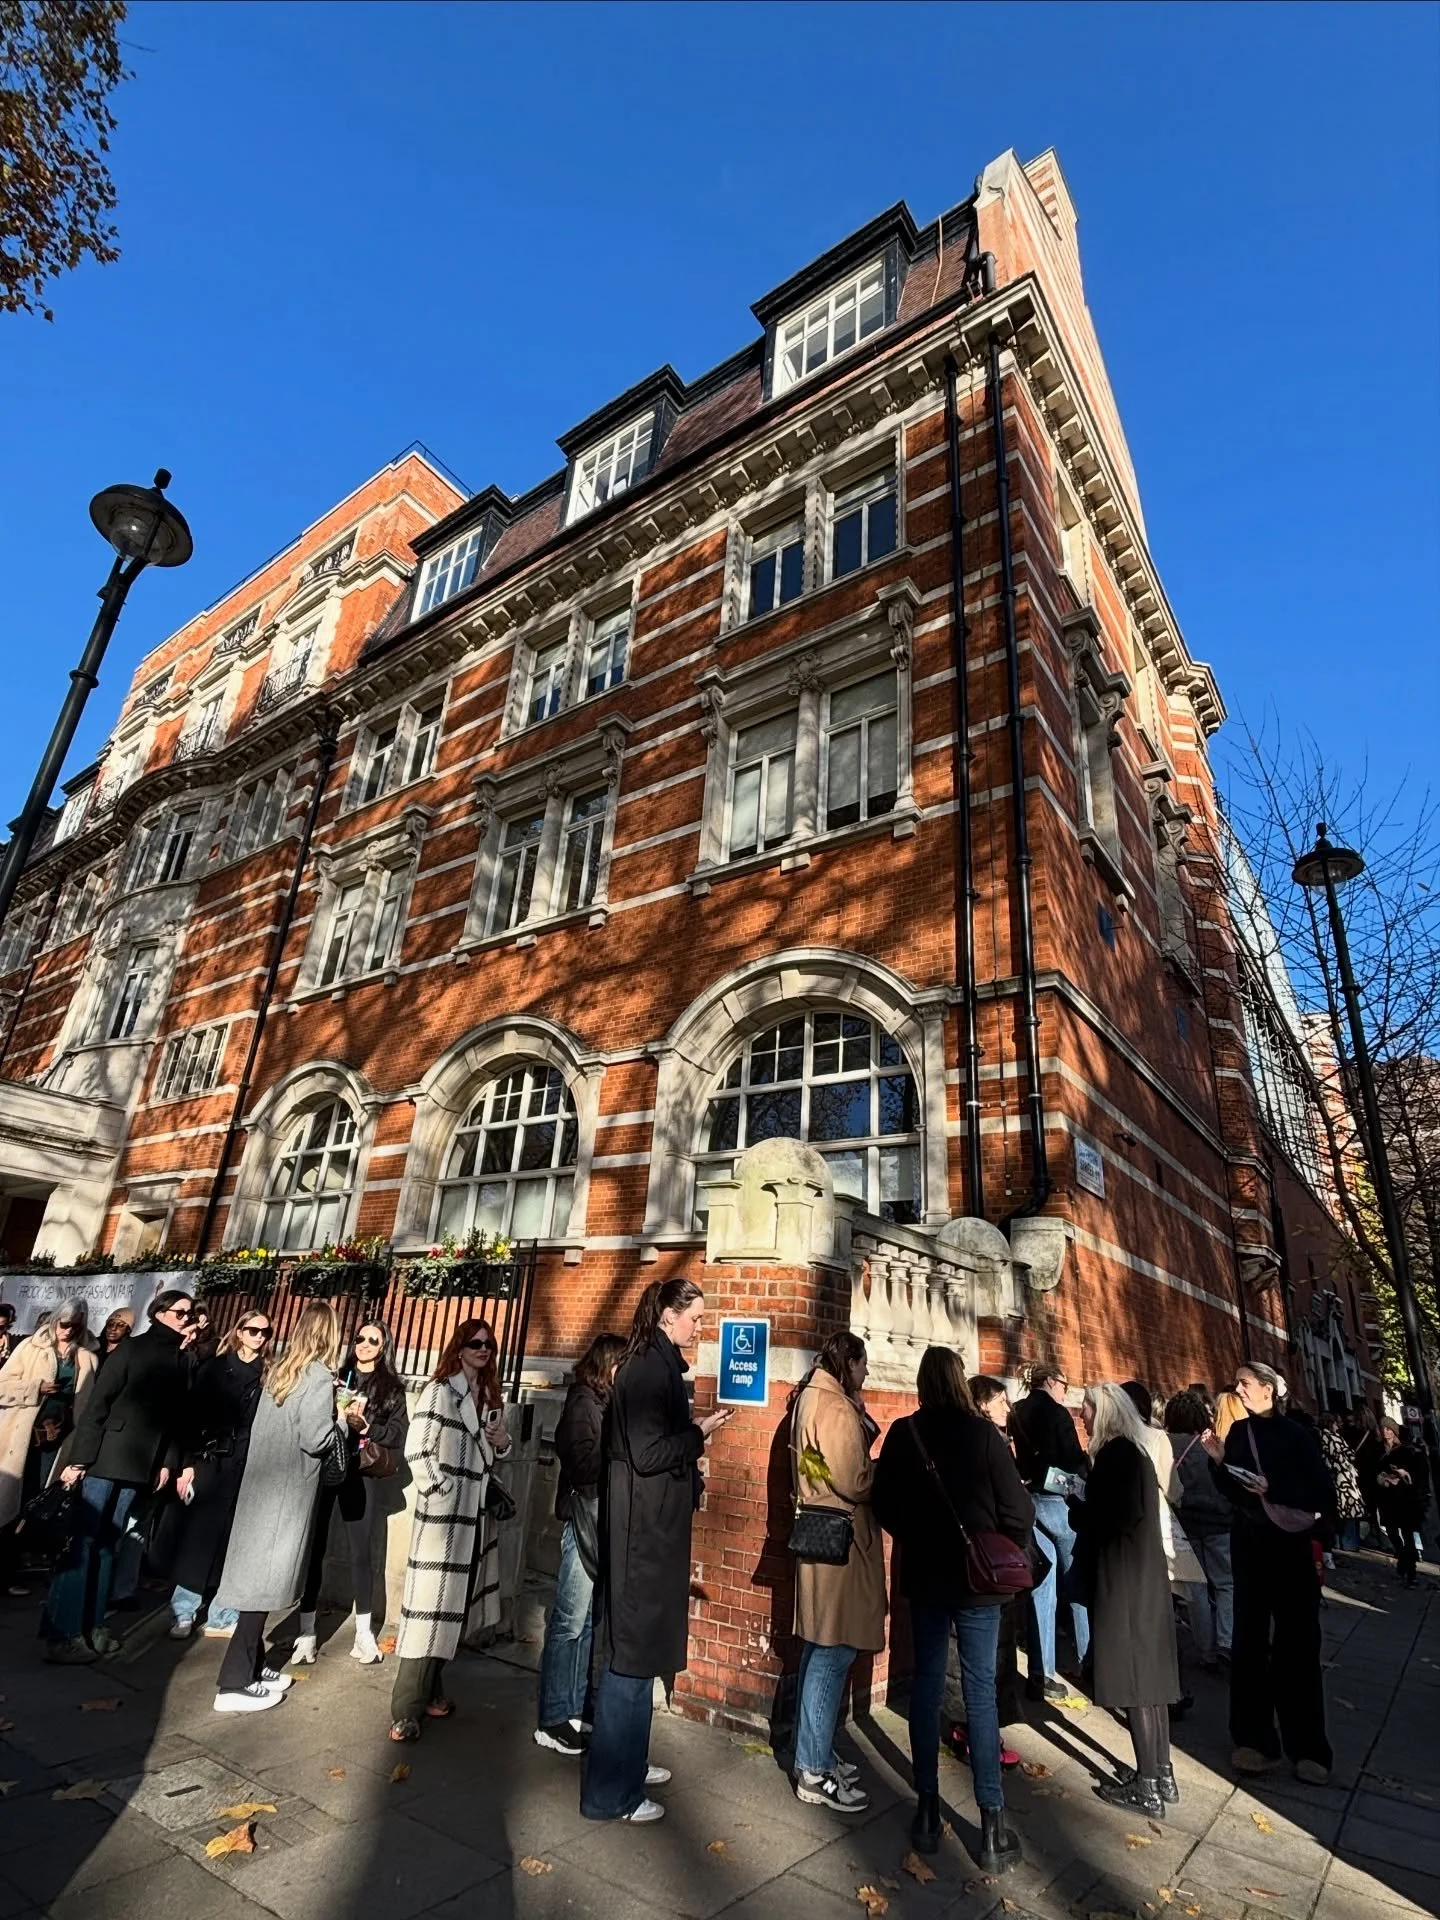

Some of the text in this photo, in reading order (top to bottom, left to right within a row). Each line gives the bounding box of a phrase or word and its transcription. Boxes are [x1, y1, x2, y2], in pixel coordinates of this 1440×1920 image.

[85, 1284, 118, 1299] FASHION
[118, 1283, 134, 1299] FAIR
[729, 1358, 757, 1371] Access
[732, 1374, 753, 1387] ramp
[822, 1779, 837, 1794] N
